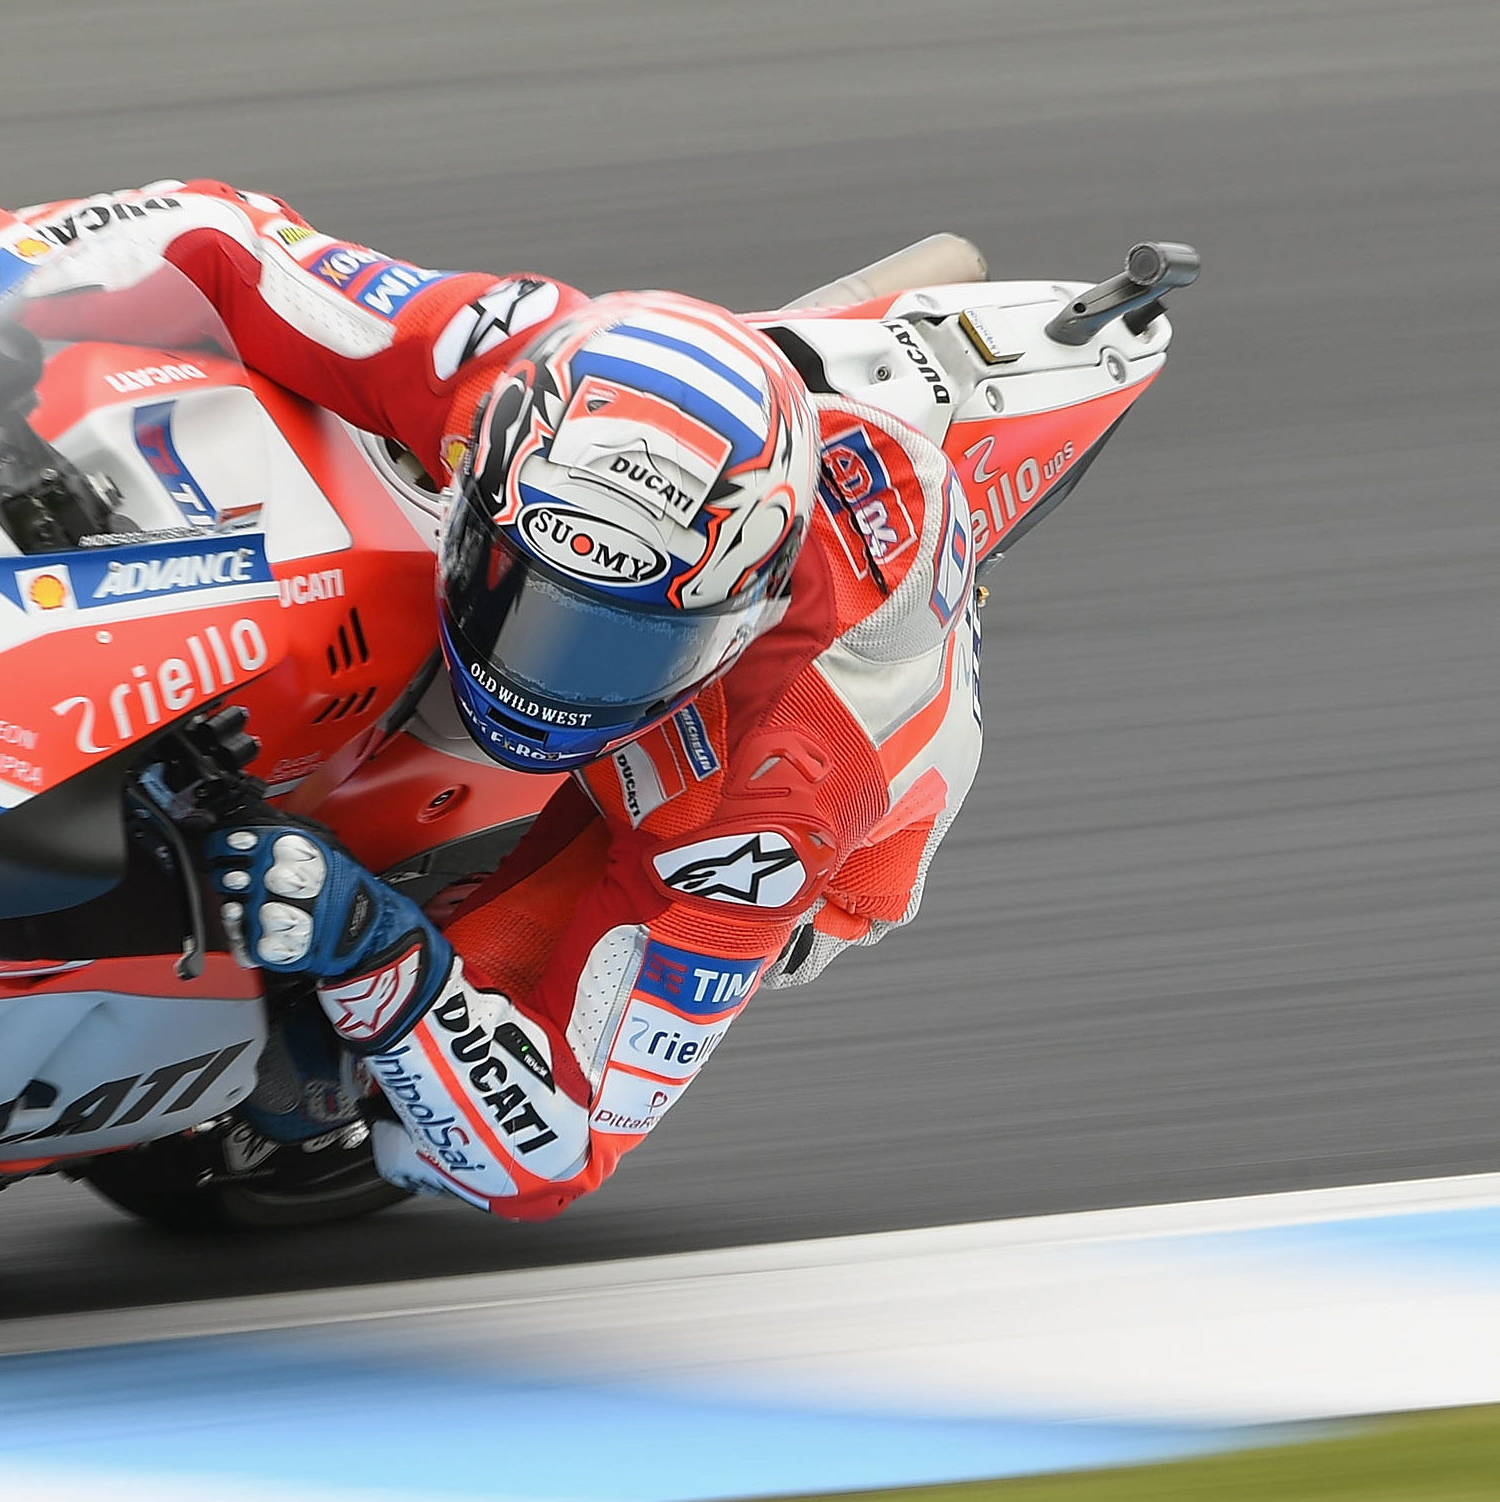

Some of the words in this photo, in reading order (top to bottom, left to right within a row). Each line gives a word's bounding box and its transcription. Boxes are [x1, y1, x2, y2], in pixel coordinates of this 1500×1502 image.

[104, 363, 207, 392] DUCATI
[171, 482, 217, 528] TI
[610, 456, 694, 512] DUCATI
[970, 457, 1041, 554] ello
[1043, 440, 1075, 480] ups
[93, 548, 256, 599] ADVANCE
[534, 510, 652, 581] SUOMY
[278, 567, 345, 608] UCATI
[109, 618, 268, 740] riello
[470, 663, 497, 693] OLD
[498, 685, 540, 717] WILD
[541, 707, 592, 727] WEST
[617, 753, 641, 817] DUCATI
[693, 967, 757, 1003] TIM
[432, 991, 558, 1155] DUCATI
